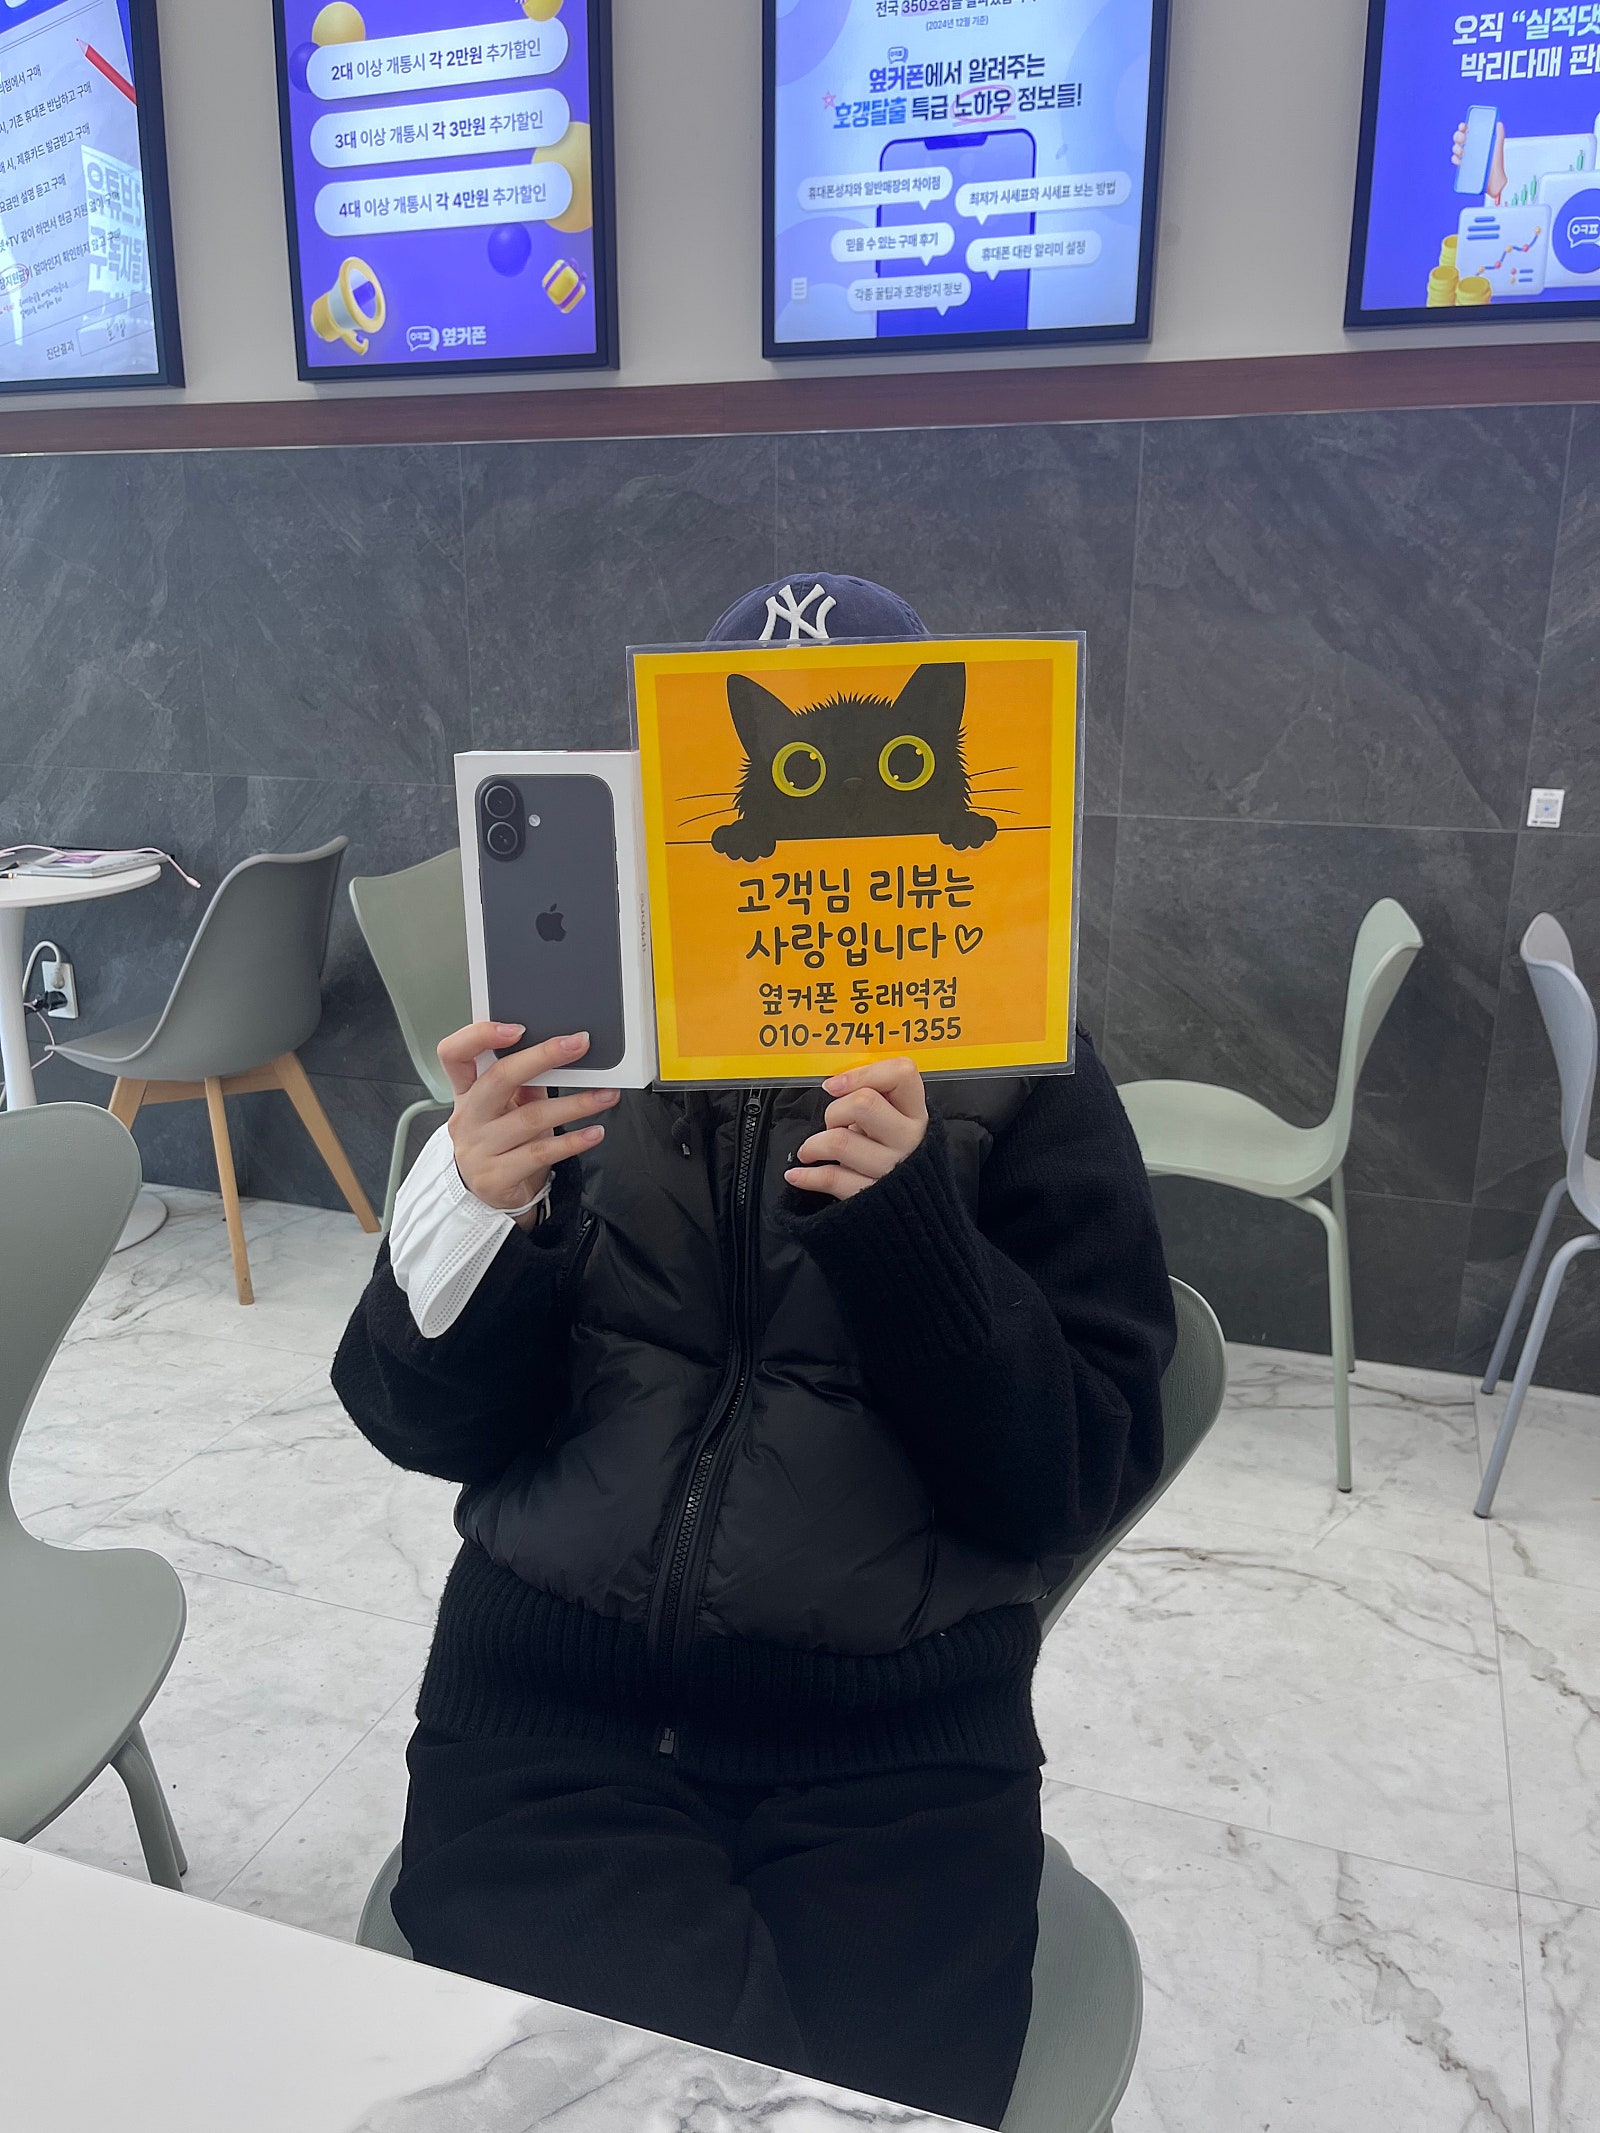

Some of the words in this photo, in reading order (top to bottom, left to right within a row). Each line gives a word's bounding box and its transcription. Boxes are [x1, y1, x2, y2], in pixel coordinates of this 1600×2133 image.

[875, 1, 899, 17] 전국
[926, 19, 954, 31] (2024년
[955, 17, 970, 28] 12월
[971, 15, 989, 26] 기준)
[1452, 12, 1504, 45] 오직
[26, 64, 42, 81] 구매
[331, 65, 353, 81] 2대
[357, 60, 383, 79] 이상
[386, 52, 426, 75] 개통시
[429, 52, 443, 70] 각
[446, 45, 483, 67] 2만원
[486, 38, 542, 63] 추가할인
[869, 60, 962, 93] 옆커폰에서
[969, 53, 1046, 84] 알려주는
[1460, 46, 1562, 82] 박리다매
[1569, 43, 1600, 76] 판
[9, 113, 24, 128] 기존
[25, 102, 46, 124] 휴대폰
[47, 89, 76, 112] 반납하고
[77, 81, 92, 98] 구매
[833, 98, 907, 129] 호갱탈출
[911, 94, 948, 121] 특급
[954, 89, 1012, 118] 노하우
[1018, 82, 1083, 112] 정보들!
[17, 144, 45, 164] 제휴카드
[45, 131, 75, 153] 발급받고
[75, 122, 91, 139] 구매
[334, 131, 357, 149] 3대
[360, 127, 386, 147] 이상
[390, 123, 429, 144] 개통시
[432, 122, 446, 139] 각
[449, 117, 486, 138] 3만원
[489, 110, 543, 133] 추가할인
[21, 187, 35, 204] 설명
[36, 181, 51, 197] 듣고
[51, 173, 66, 190] 구매
[338, 200, 361, 219] 4대
[363, 197, 390, 217] 이상
[393, 193, 432, 215] 개통시
[435, 192, 449, 210] 각
[453, 188, 489, 209] 4만원
[492, 183, 546, 206] 추가할인
[864, 178, 910, 196] 일반매장의
[912, 176, 941, 191] 차이점
[970, 190, 998, 206] 최저가
[1000, 187, 1039, 204] 시세표와
[1041, 185, 1071, 201] 시세표
[1074, 183, 1094, 198] 보는
[1096, 181, 1116, 196] 방법
[20, 226, 35, 243] 같이
[35, 216, 57, 236] 하면서
[57, 208, 73, 226] 현금
[73, 202, 88, 218] 지원
[88, 195, 104, 213] 없이
[33, 252, 62, 276] 얼마인지
[62, 241, 91, 262] 확인하지
[866, 238, 876, 250] 수
[878, 236, 896, 250] 있는
[898, 234, 918, 248] 구매
[919, 232, 939, 247] 후기
[982, 247, 1010, 261] 휴대폰
[1035, 242, 1063, 257] 알리미
[1066, 240, 1086, 255] 설정
[855, 288, 873, 301] 각종
[943, 282, 963, 295] 정보
[46, 340, 74, 361] 진단결과
[441, 325, 487, 347] 옆커폰
[759, 583, 837, 643] NY
[737, 868, 850, 915] 고객님
[869, 864, 975, 909] 리뷰는
[746, 921, 947, 969] 사랑입니다
[759, 982, 838, 1015] 옆커폰
[850, 976, 957, 1014] 동래역점
[759, 1016, 962, 1047] 010-2741-1355
